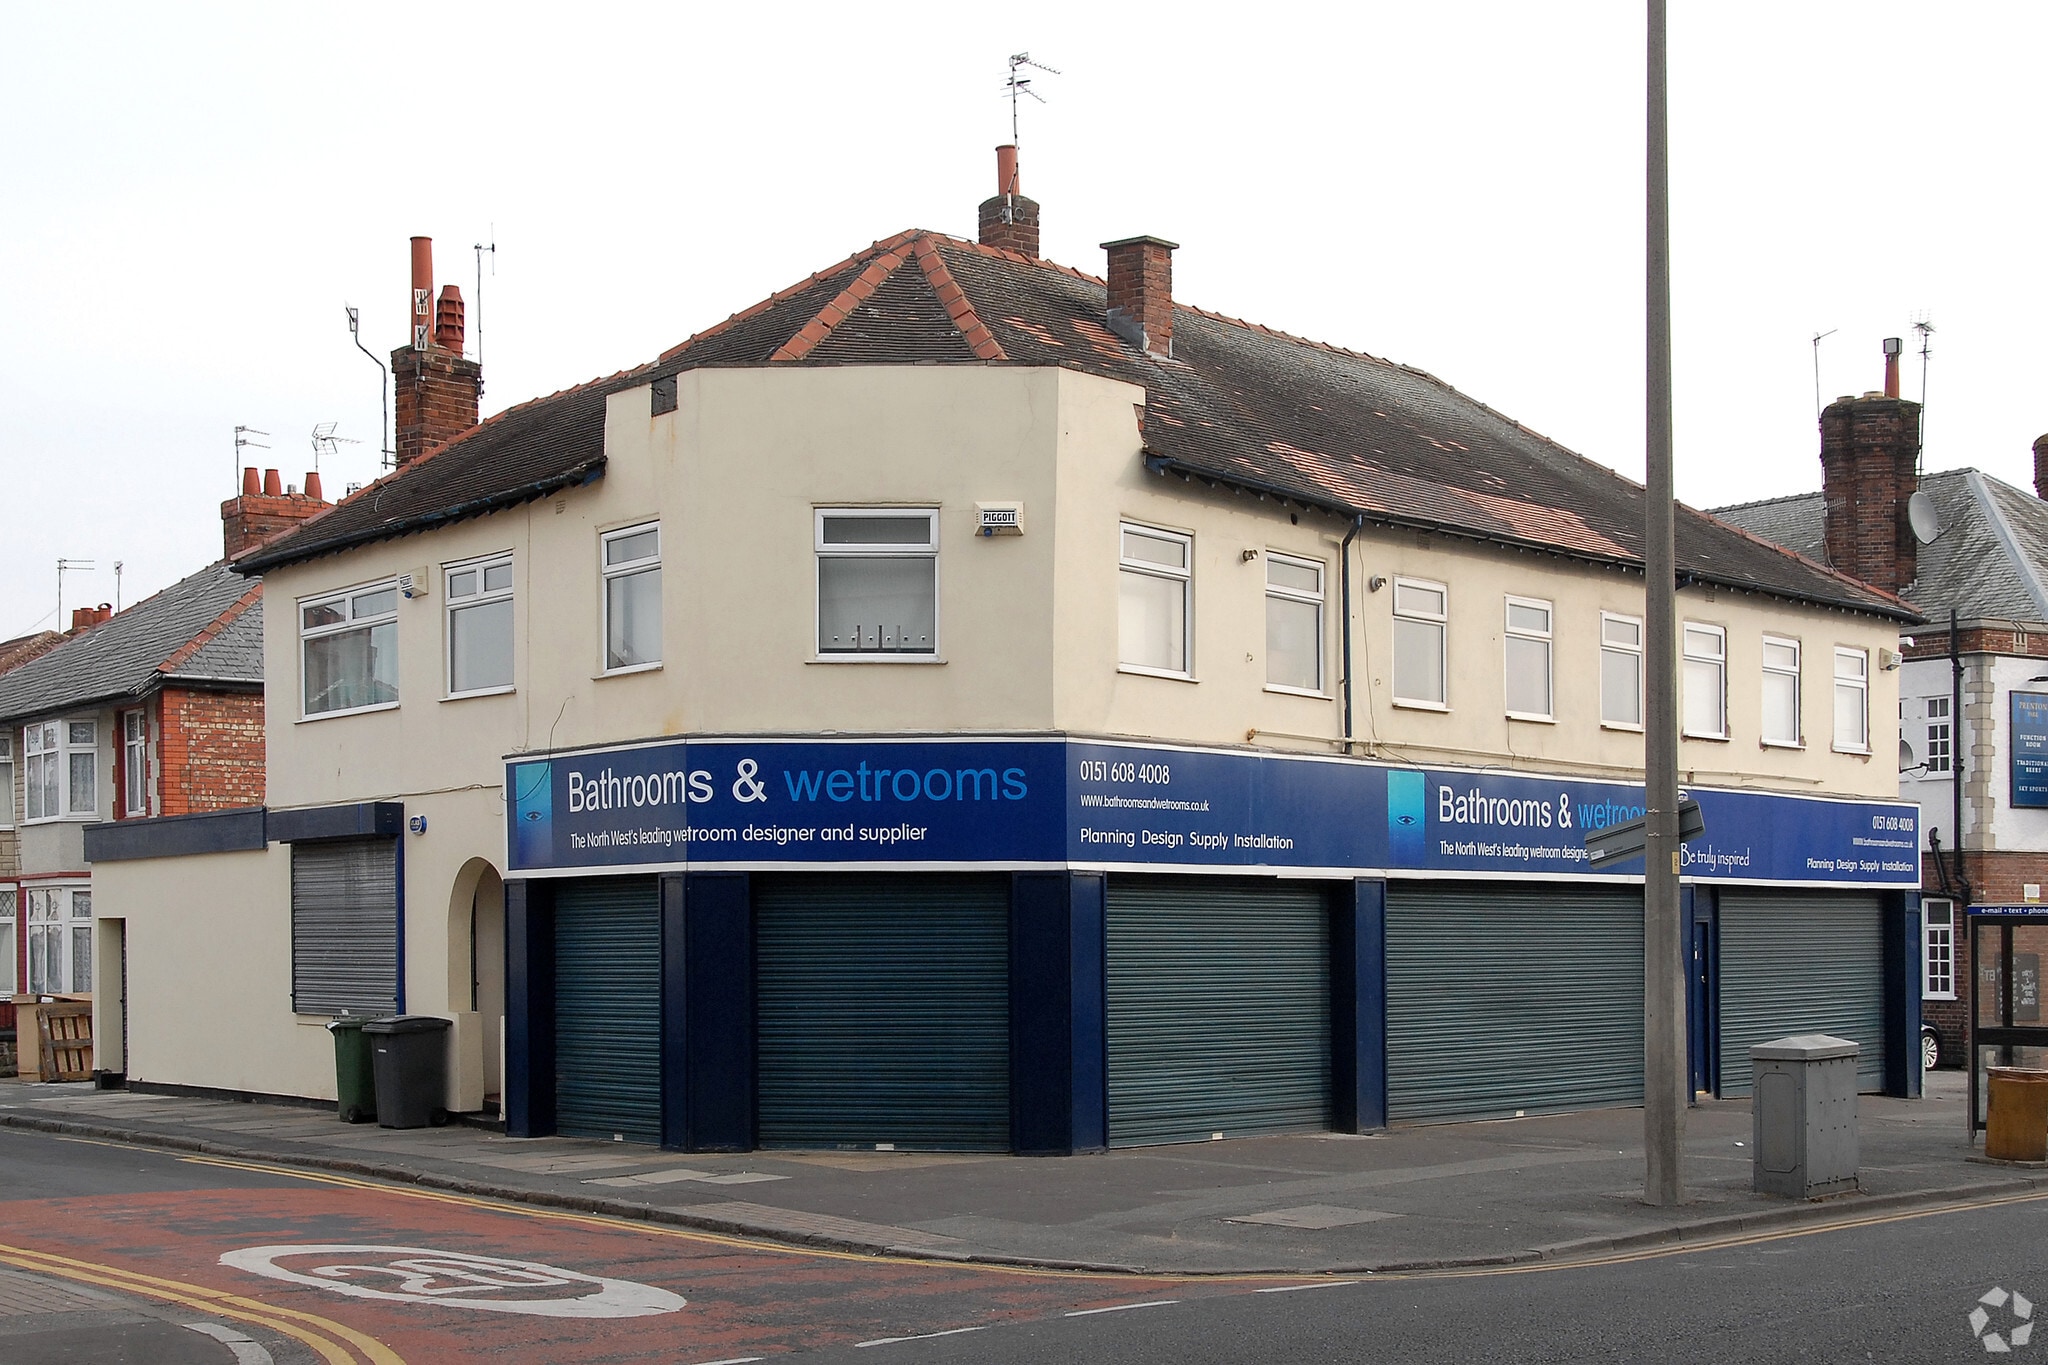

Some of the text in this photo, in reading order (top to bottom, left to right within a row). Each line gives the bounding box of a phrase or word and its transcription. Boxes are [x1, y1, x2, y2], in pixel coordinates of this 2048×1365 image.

[983, 513, 1015, 522] PIGGOTT
[2019, 733, 2047, 741] FUNCTION
[1080, 760, 1170, 785] 0151 608 4008
[568, 758, 1028, 813] Bathrooms & wetrooms
[2029, 785, 2048, 793] SPORTS
[1439, 785, 1647, 829] Bathrooms & wetroo
[1872, 815, 1914, 832] 0151 608 4008
[570, 823, 928, 849] The North West's leading wetroom designer and supplier
[1080, 827, 1294, 850] Planning Design Supply Installation
[1439, 840, 1454, 856] The
[1455, 841, 1476, 857] North
[1477, 842, 1501, 857] West's
[1502, 843, 1529, 861] leading
[1530, 845, 1560, 860] wetroom
[1561, 845, 1589, 862] designe
[1680, 842, 1750, 873] Be truly inspired
[1806, 857, 1914, 873] Planning Design Supply Installation
